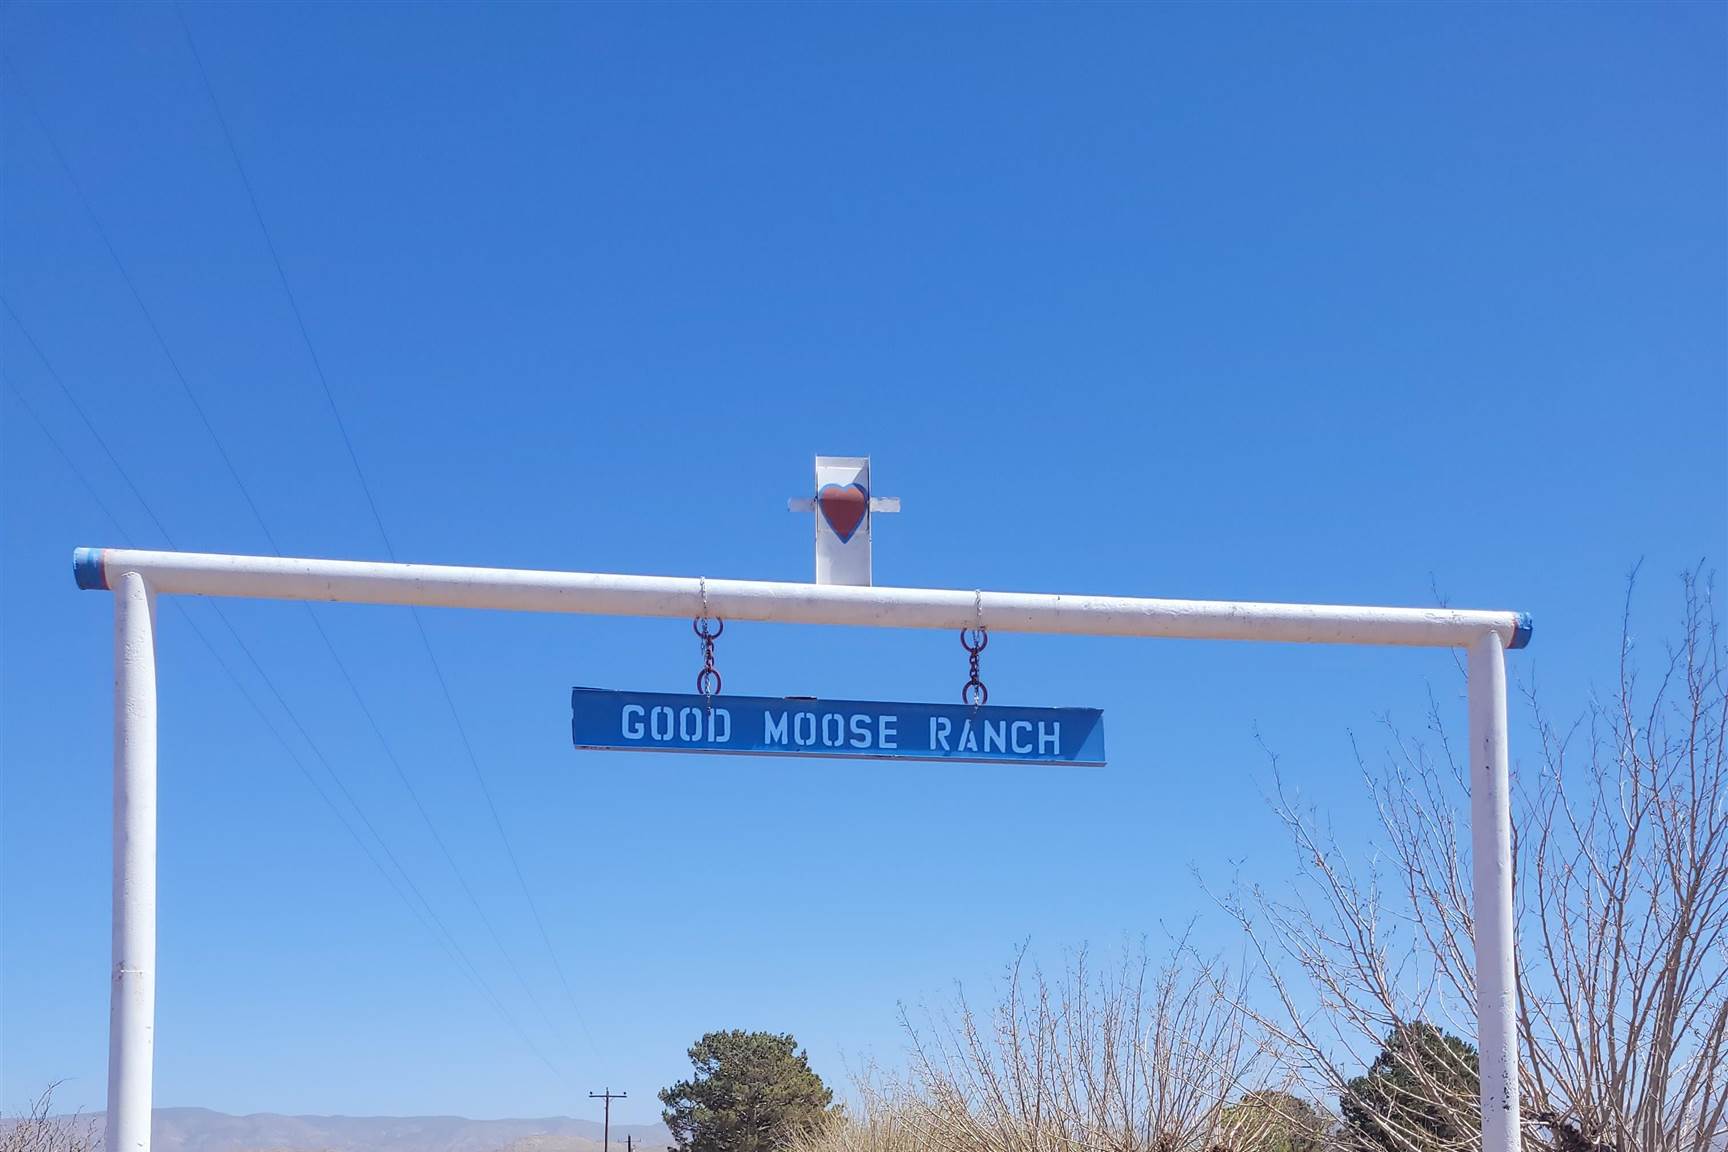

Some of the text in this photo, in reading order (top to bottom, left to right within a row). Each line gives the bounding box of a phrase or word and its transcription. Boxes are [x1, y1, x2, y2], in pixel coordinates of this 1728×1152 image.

[621, 704, 1061, 755] GOOD MOOSE RANCH
